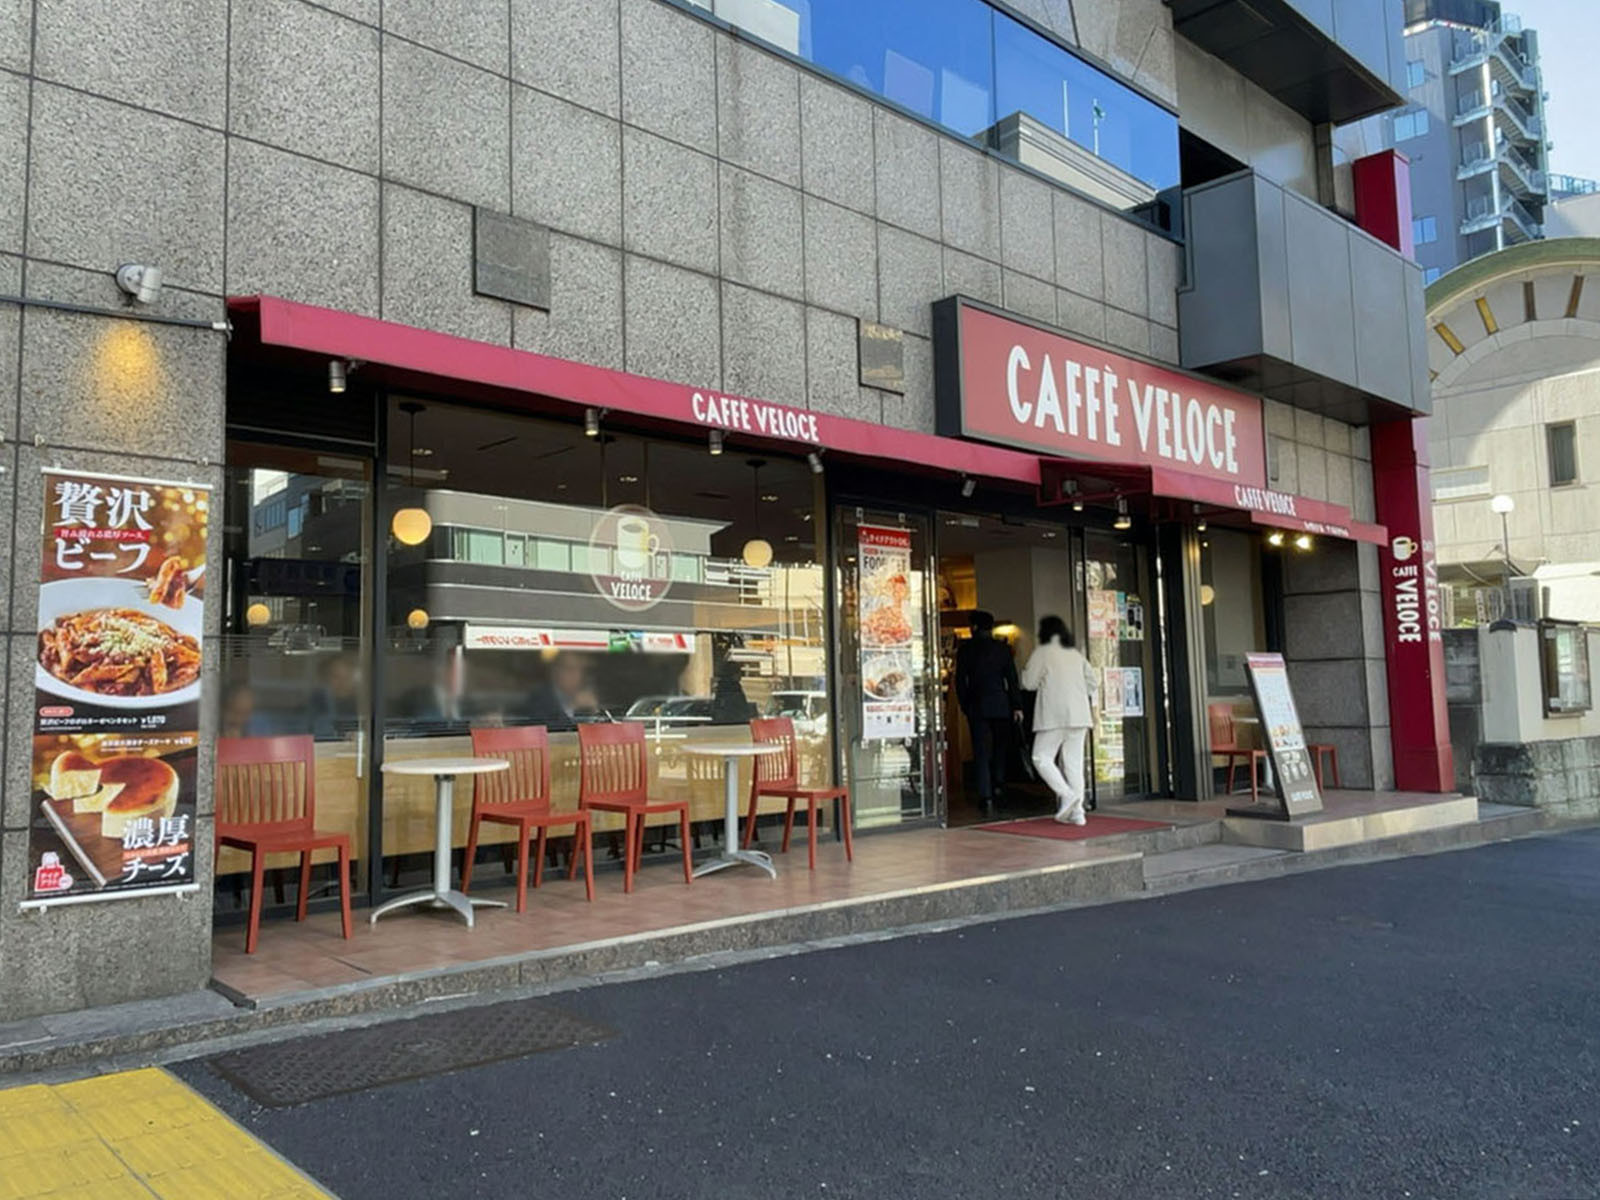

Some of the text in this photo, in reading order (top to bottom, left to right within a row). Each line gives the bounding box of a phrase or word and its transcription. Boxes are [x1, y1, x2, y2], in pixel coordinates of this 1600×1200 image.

[753, 403, 820, 442] VELOCE
[1007, 345, 1239, 474] CAFFÈ VELOCE
[52, 480, 154, 530] 贅沢
[54, 537, 151, 574] ビーフ
[611, 581, 652, 601] VELOCE
[1395, 578, 1422, 642] VELOCE
[1424, 560, 1441, 642] VELOCE
[123, 814, 189, 849] 濃厚
[122, 852, 189, 883] チーズ
